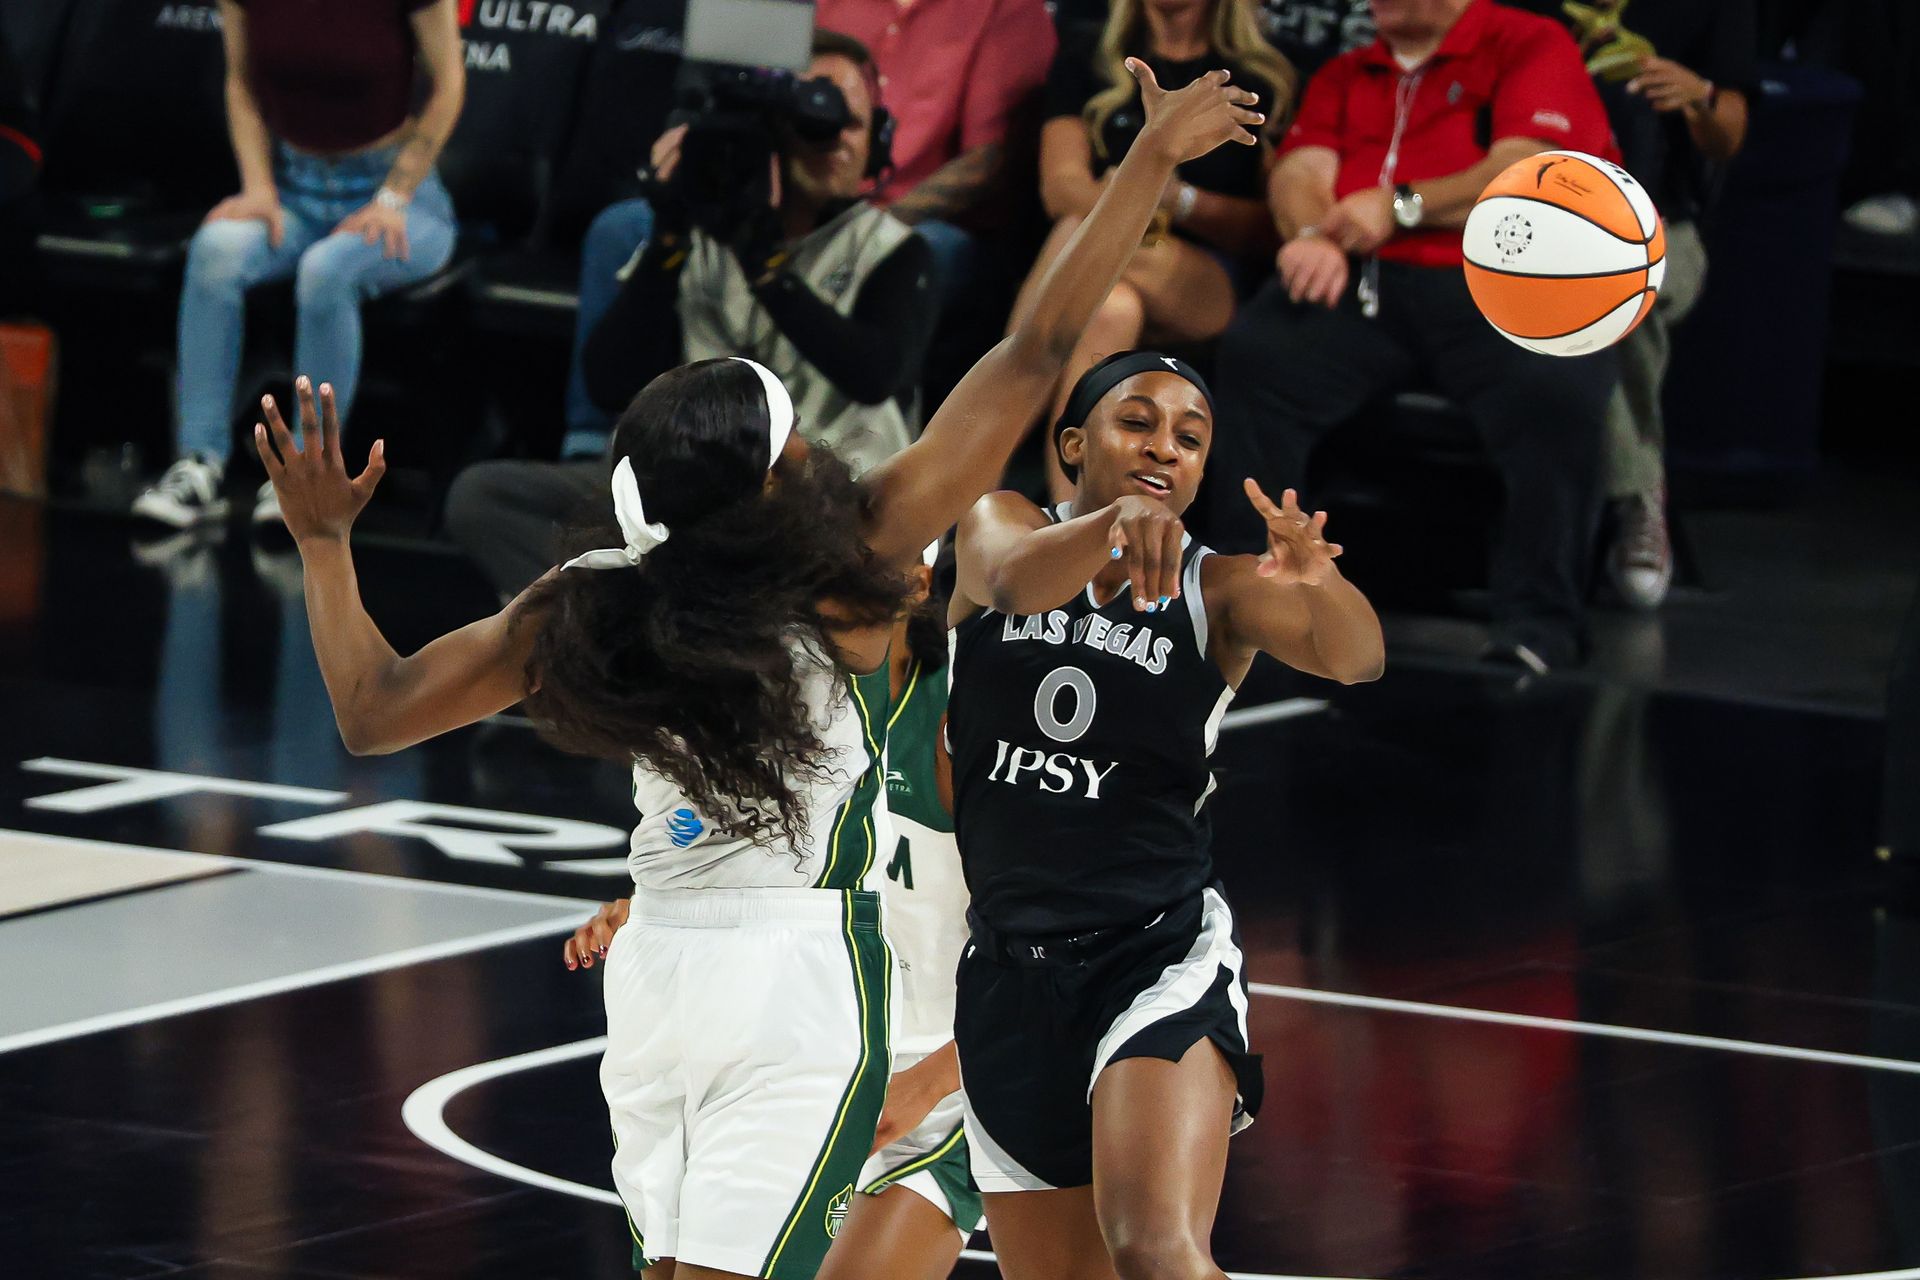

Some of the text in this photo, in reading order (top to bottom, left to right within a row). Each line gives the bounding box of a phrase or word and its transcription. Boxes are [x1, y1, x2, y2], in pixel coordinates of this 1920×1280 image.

[156, 5, 224, 30] AREN
[479, 0, 597, 41] ULTRA
[1002, 610, 1173, 675] LAS VEGAS
[1034, 666, 1096, 742] 0
[988, 740, 1119, 799] IPSY
